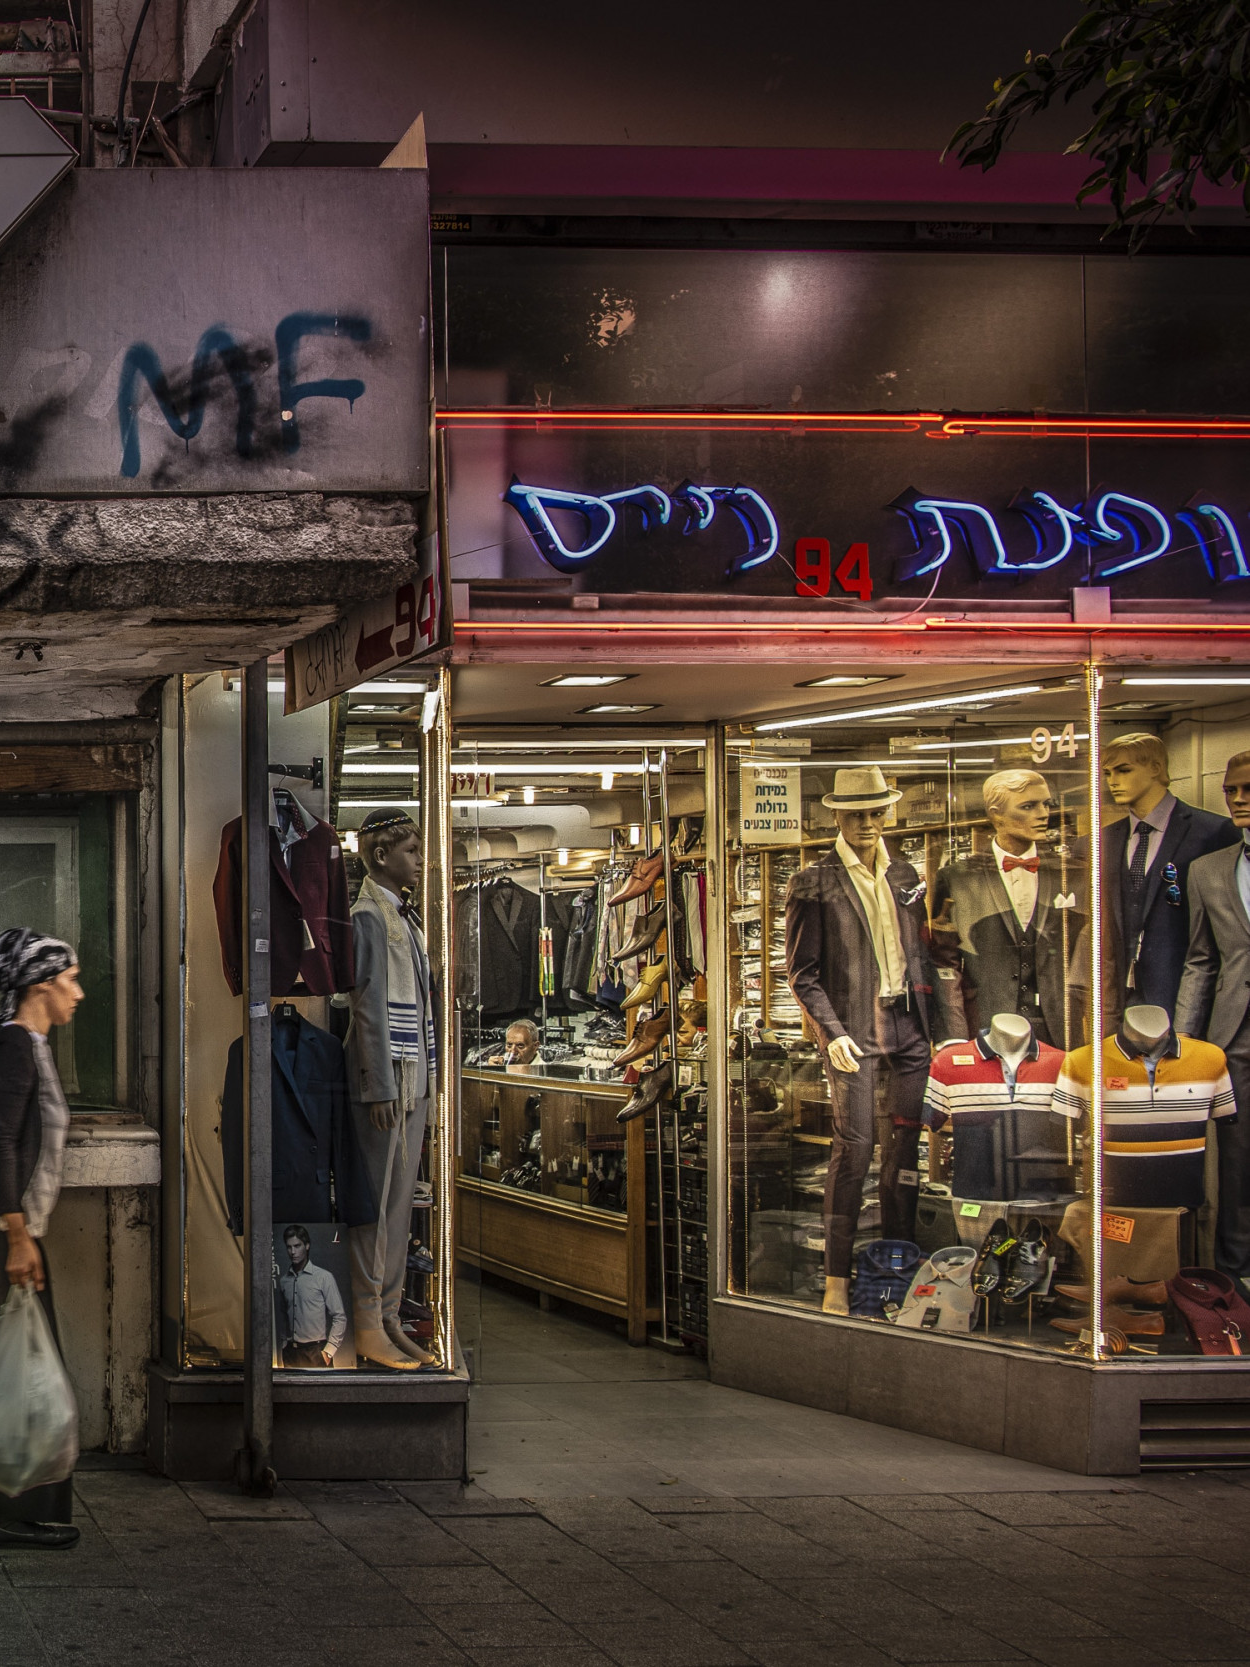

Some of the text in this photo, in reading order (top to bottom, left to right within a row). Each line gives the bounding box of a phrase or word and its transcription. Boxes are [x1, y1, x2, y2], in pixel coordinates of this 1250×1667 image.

[900, 490, 1250, 578] ופנת
[795, 537, 873, 600] 94
[395, 574, 436, 657] 94
[1031, 723, 1078, 763] 94
[755, 785, 787, 796] במידות
[755, 800, 788, 813] גדולות
[744, 819, 771, 830] צבעים
